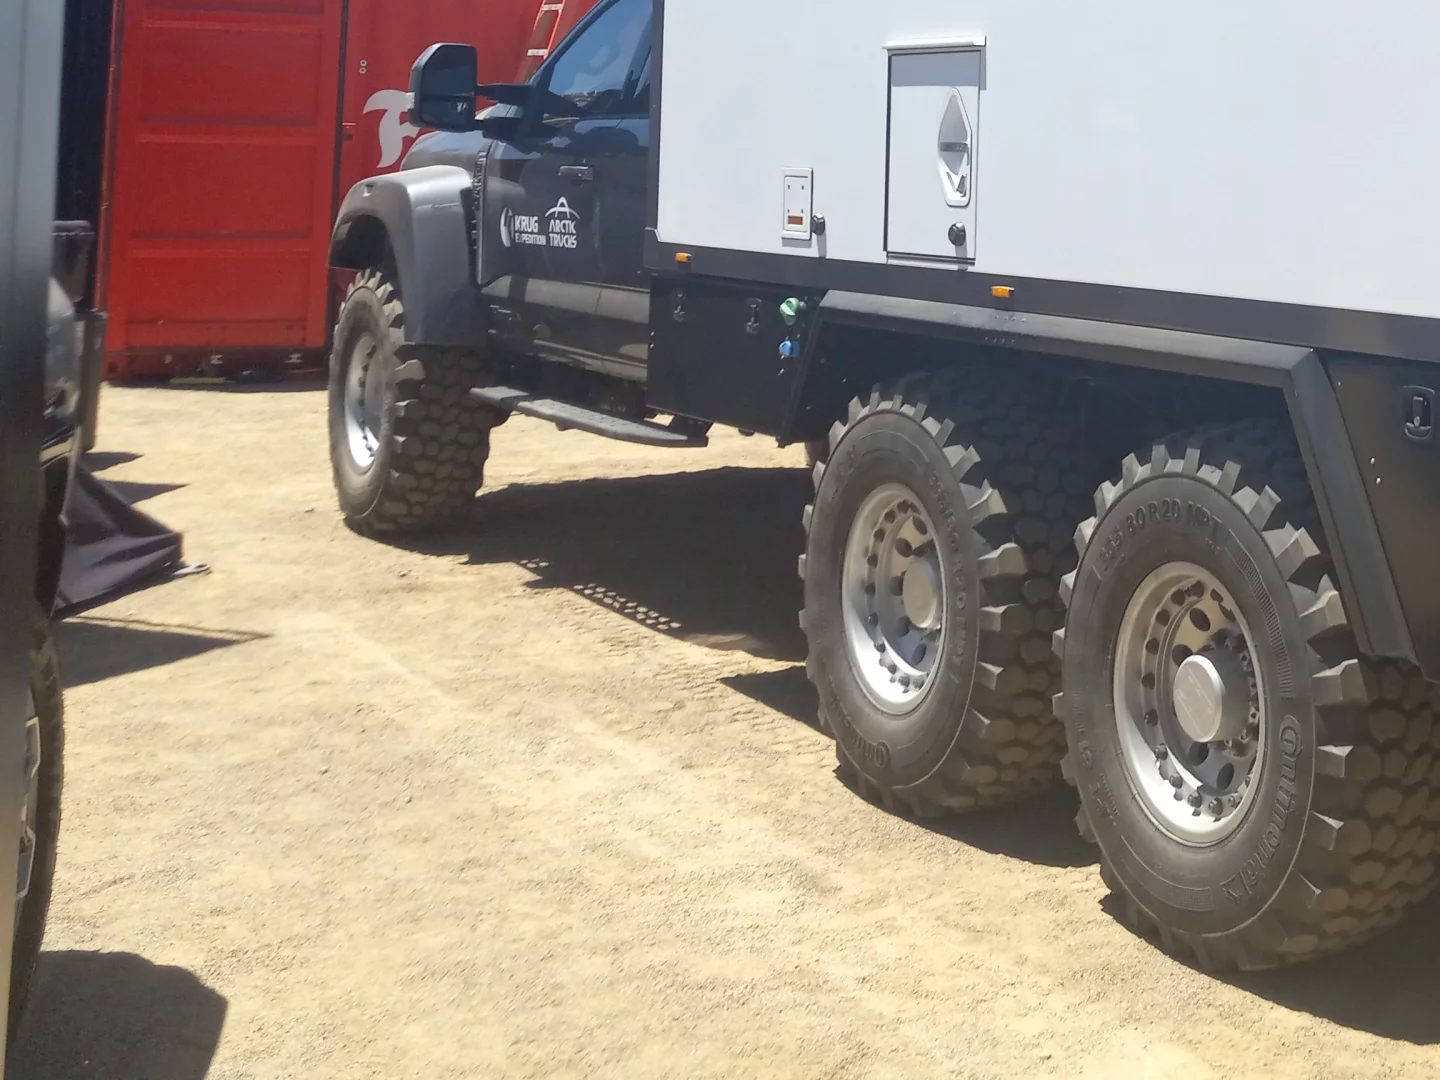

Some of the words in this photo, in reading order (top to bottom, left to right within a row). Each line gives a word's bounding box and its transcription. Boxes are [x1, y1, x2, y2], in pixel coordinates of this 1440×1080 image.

[514, 214, 539, 233] KRUG
[548, 218, 577, 234] ARCTIC
[548, 233, 578, 249] TRUCKS
